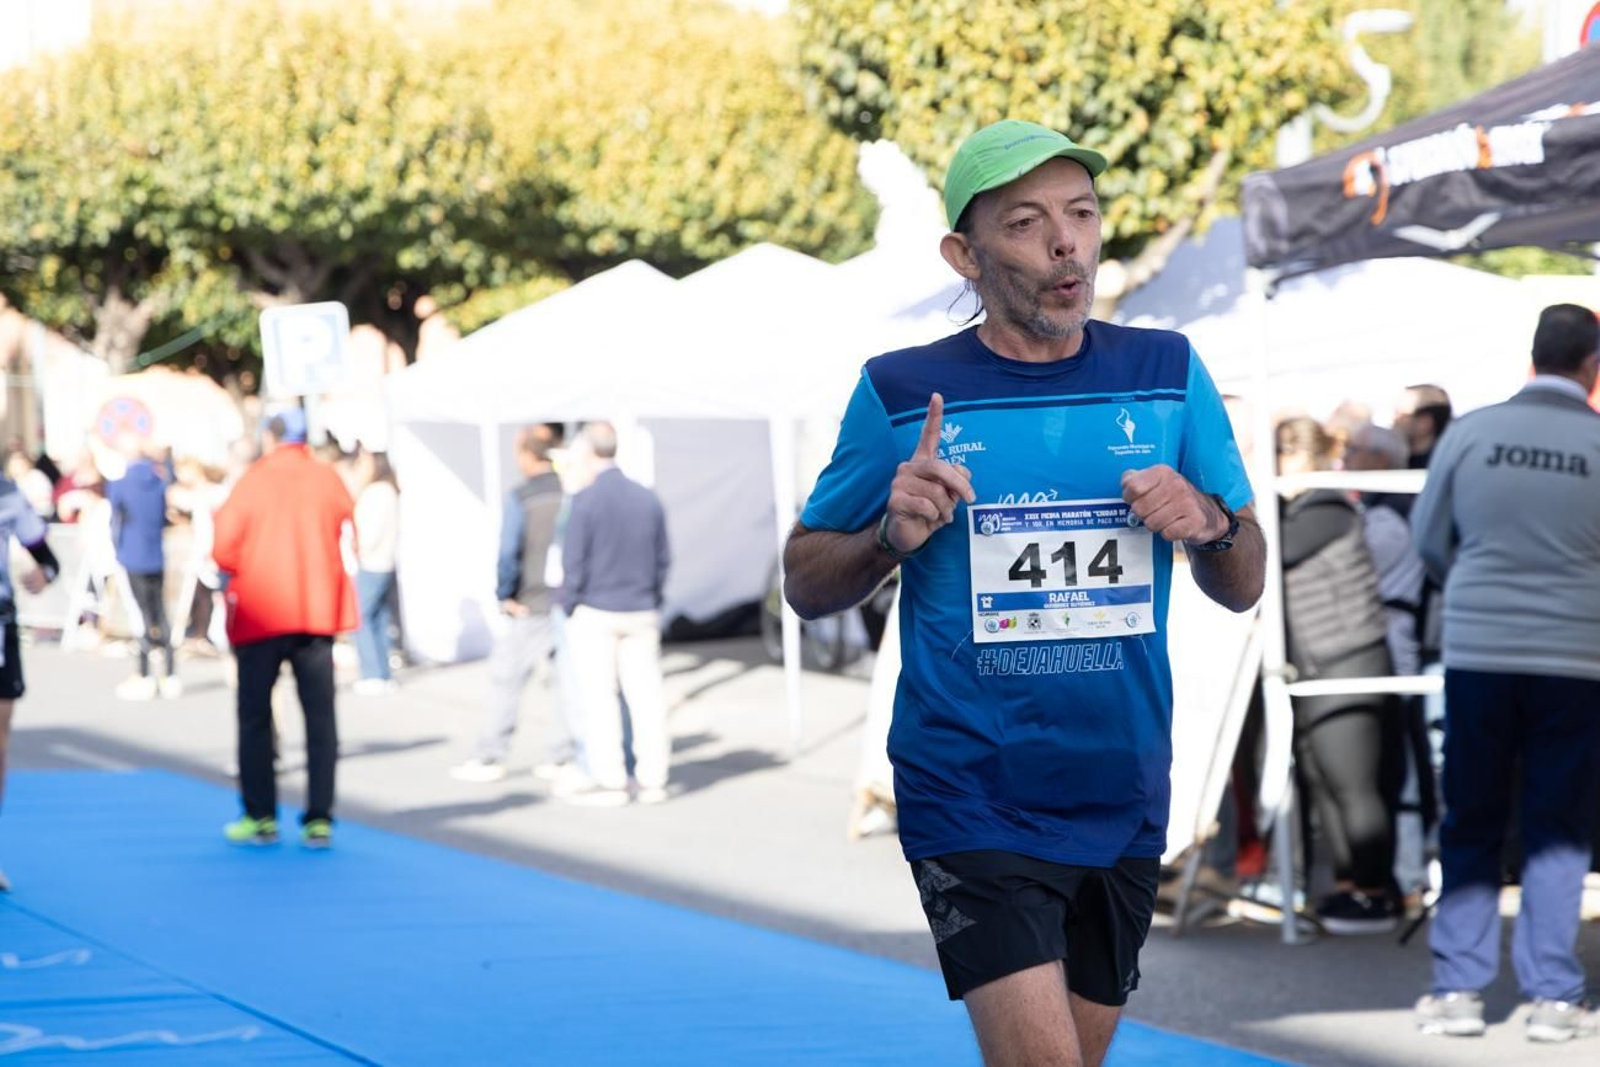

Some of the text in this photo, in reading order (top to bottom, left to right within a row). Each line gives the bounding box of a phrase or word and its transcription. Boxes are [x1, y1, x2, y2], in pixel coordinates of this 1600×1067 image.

[948, 441, 986, 456] RURAL
[1045, 519, 1054, 527] EN
[1057, 518, 1084, 527] MEMORIA
[1086, 517, 1095, 525] DE
[1008, 538, 1124, 588] 414
[1048, 591, 1090, 603] RAFAEL
[976, 642, 1125, 676] #DEJAHUELLA
